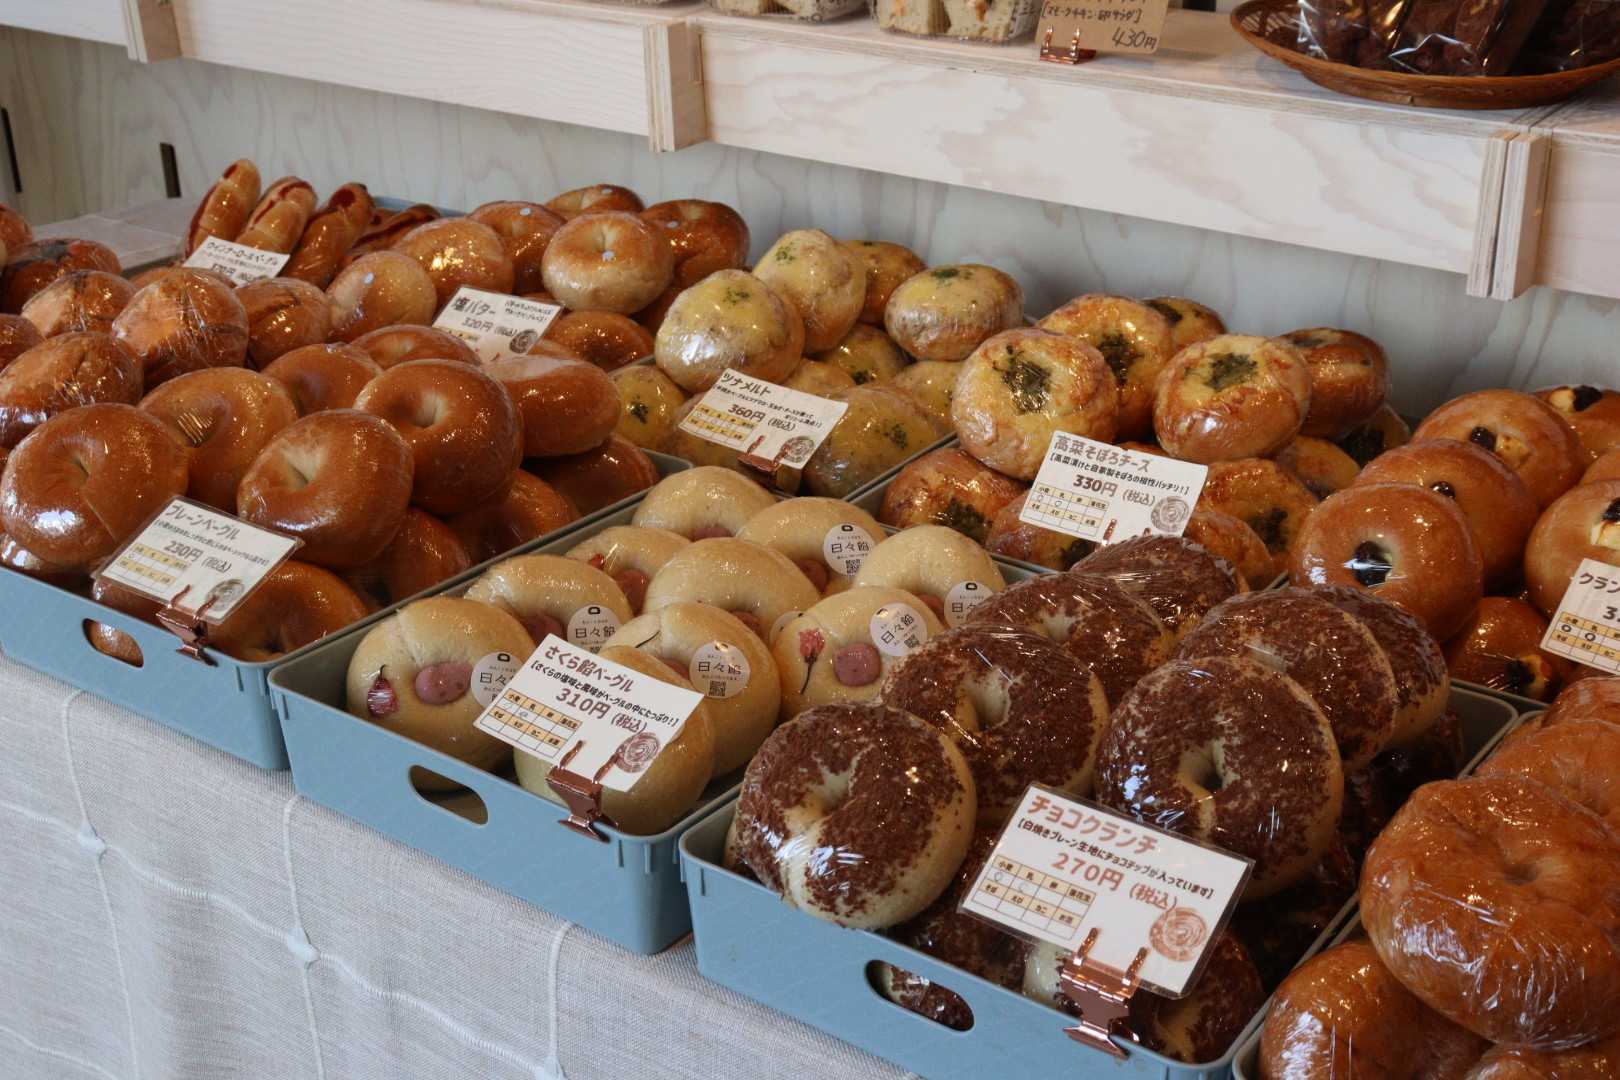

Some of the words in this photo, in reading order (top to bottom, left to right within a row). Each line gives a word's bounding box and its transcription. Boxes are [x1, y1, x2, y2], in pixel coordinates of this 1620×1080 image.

[1112, 27, 1158, 49] 430円
[450, 296, 497, 316] 塩バター
[721, 372, 773, 397] ツナメルト
[728, 403, 766, 422] 360円
[767, 416, 797, 432] (税込)
[1072, 474, 1119, 498] 330円
[1122, 488, 1156, 508] (税込)
[165, 504, 242, 541] プレーンベーグル
[163, 540, 204, 563] 230円
[201, 555, 232, 574] (税込)
[830, 541, 870, 554] 日々餡
[1579, 571, 1620, 593] クラン
[881, 613, 915, 645] 日々餡
[1602, 606, 1620, 623] 3
[544, 644, 634, 693] さくら餡ベーグル
[697, 659, 742, 675] 日々餡
[555, 687, 612, 720] 310円
[611, 711, 648, 734] (税込)
[1026, 794, 1157, 855] チョコクランチ
[998, 860, 1014, 871] 小麦
[1069, 888, 1092, 902] 落花生
[1051, 852, 1125, 892] 270円
[1129, 883, 1179, 911] (税込)
[985, 884, 998, 894] そば
[1011, 894, 1024, 904] えび
[1035, 904, 1048, 914] かに
